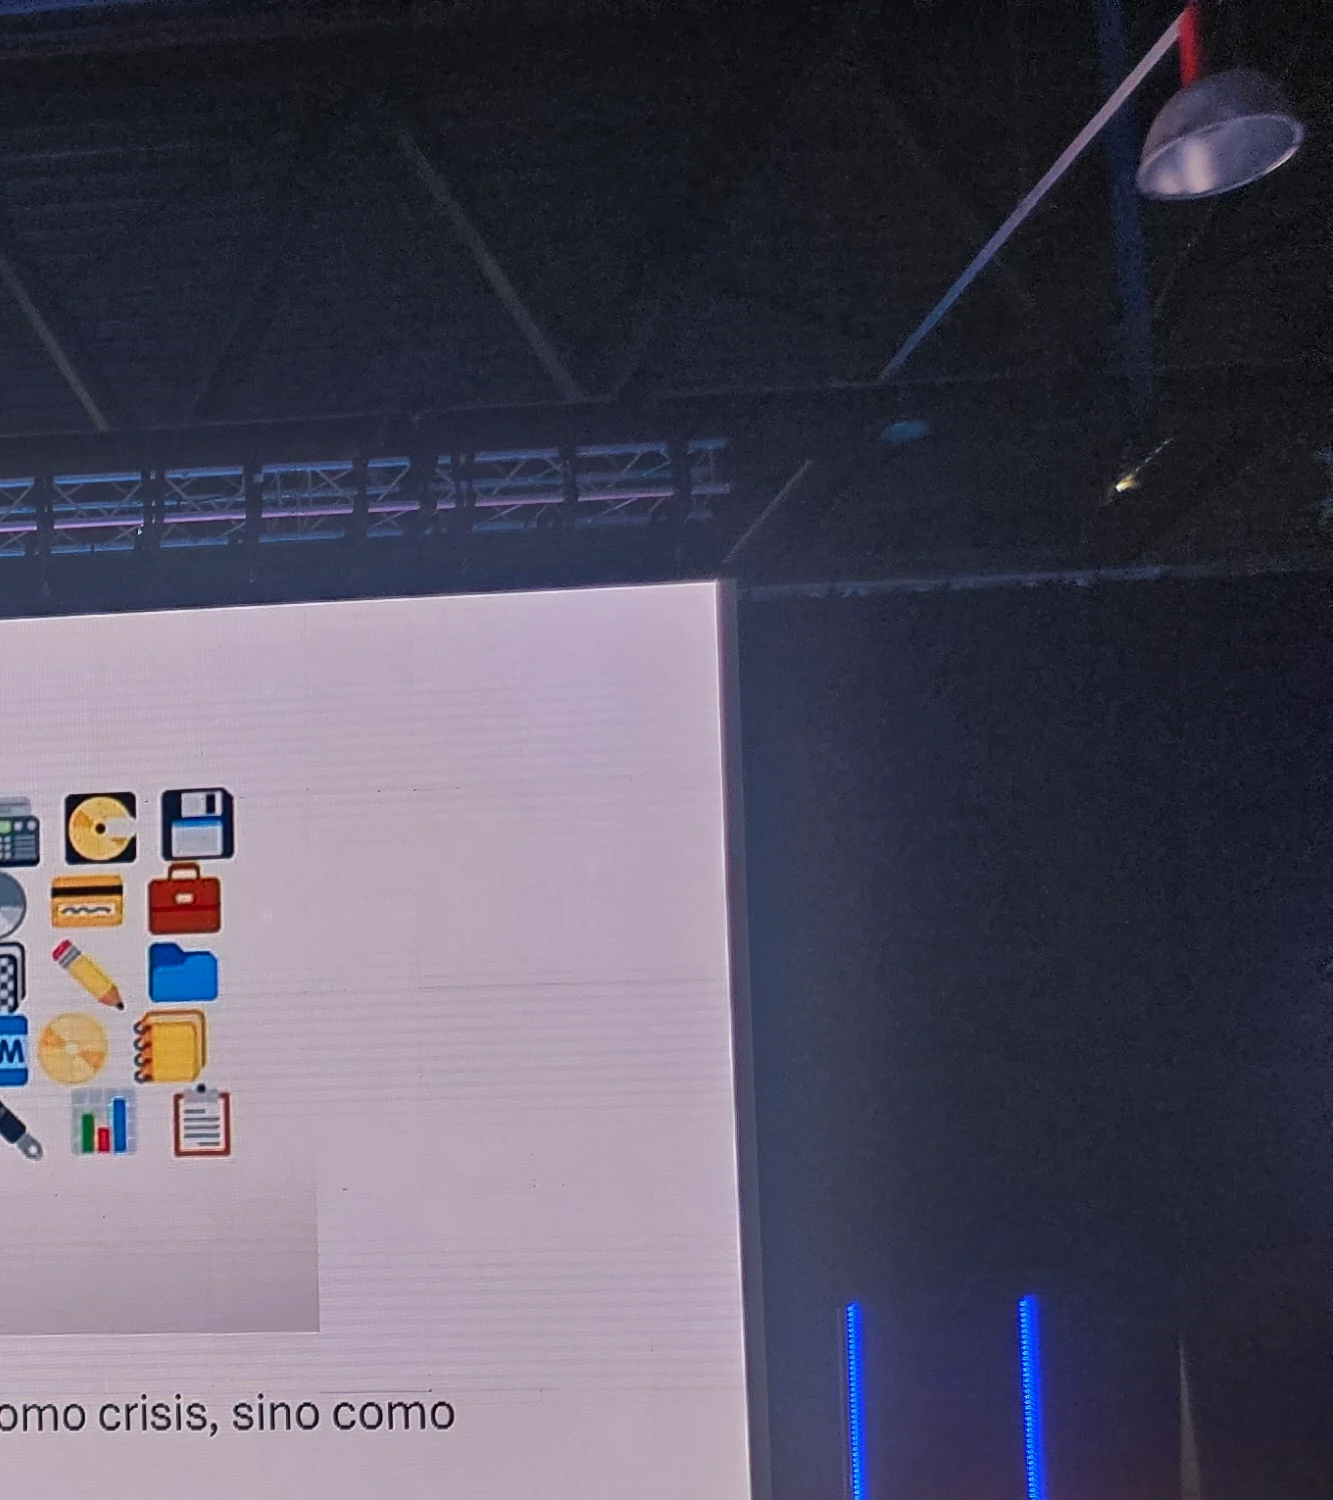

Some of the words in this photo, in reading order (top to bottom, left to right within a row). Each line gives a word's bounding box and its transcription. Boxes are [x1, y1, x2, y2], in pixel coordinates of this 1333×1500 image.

[99, 1395, 218, 1437] crisis,
[232, 1393, 320, 1431] sino
[333, 1401, 455, 1431] como
